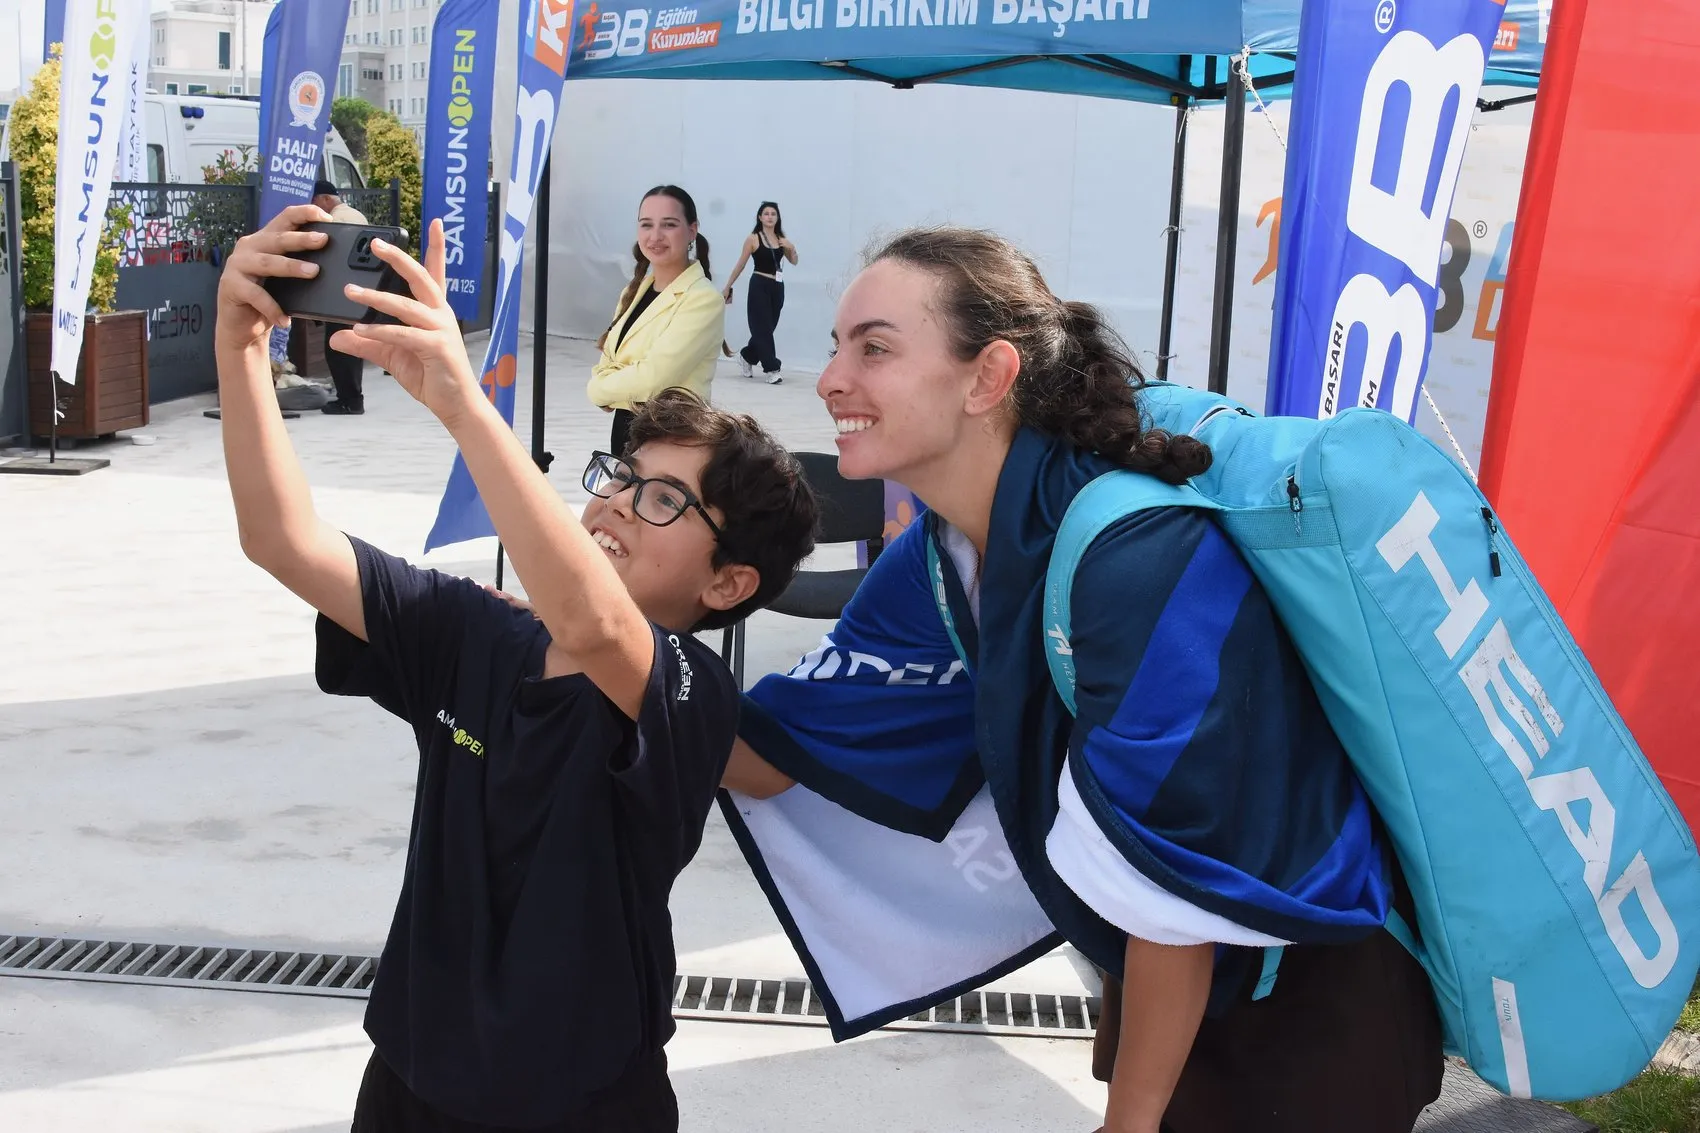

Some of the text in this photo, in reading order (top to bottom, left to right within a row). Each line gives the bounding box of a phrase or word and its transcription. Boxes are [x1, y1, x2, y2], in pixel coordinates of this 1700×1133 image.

[655, 6, 698, 31] Eğitim
[270, 156, 317, 181] DOĞAN
[460, 279, 475, 294] 125
[1324, 321, 1344, 415] BAŞARI
[1375, 489, 1680, 990] HEAD
